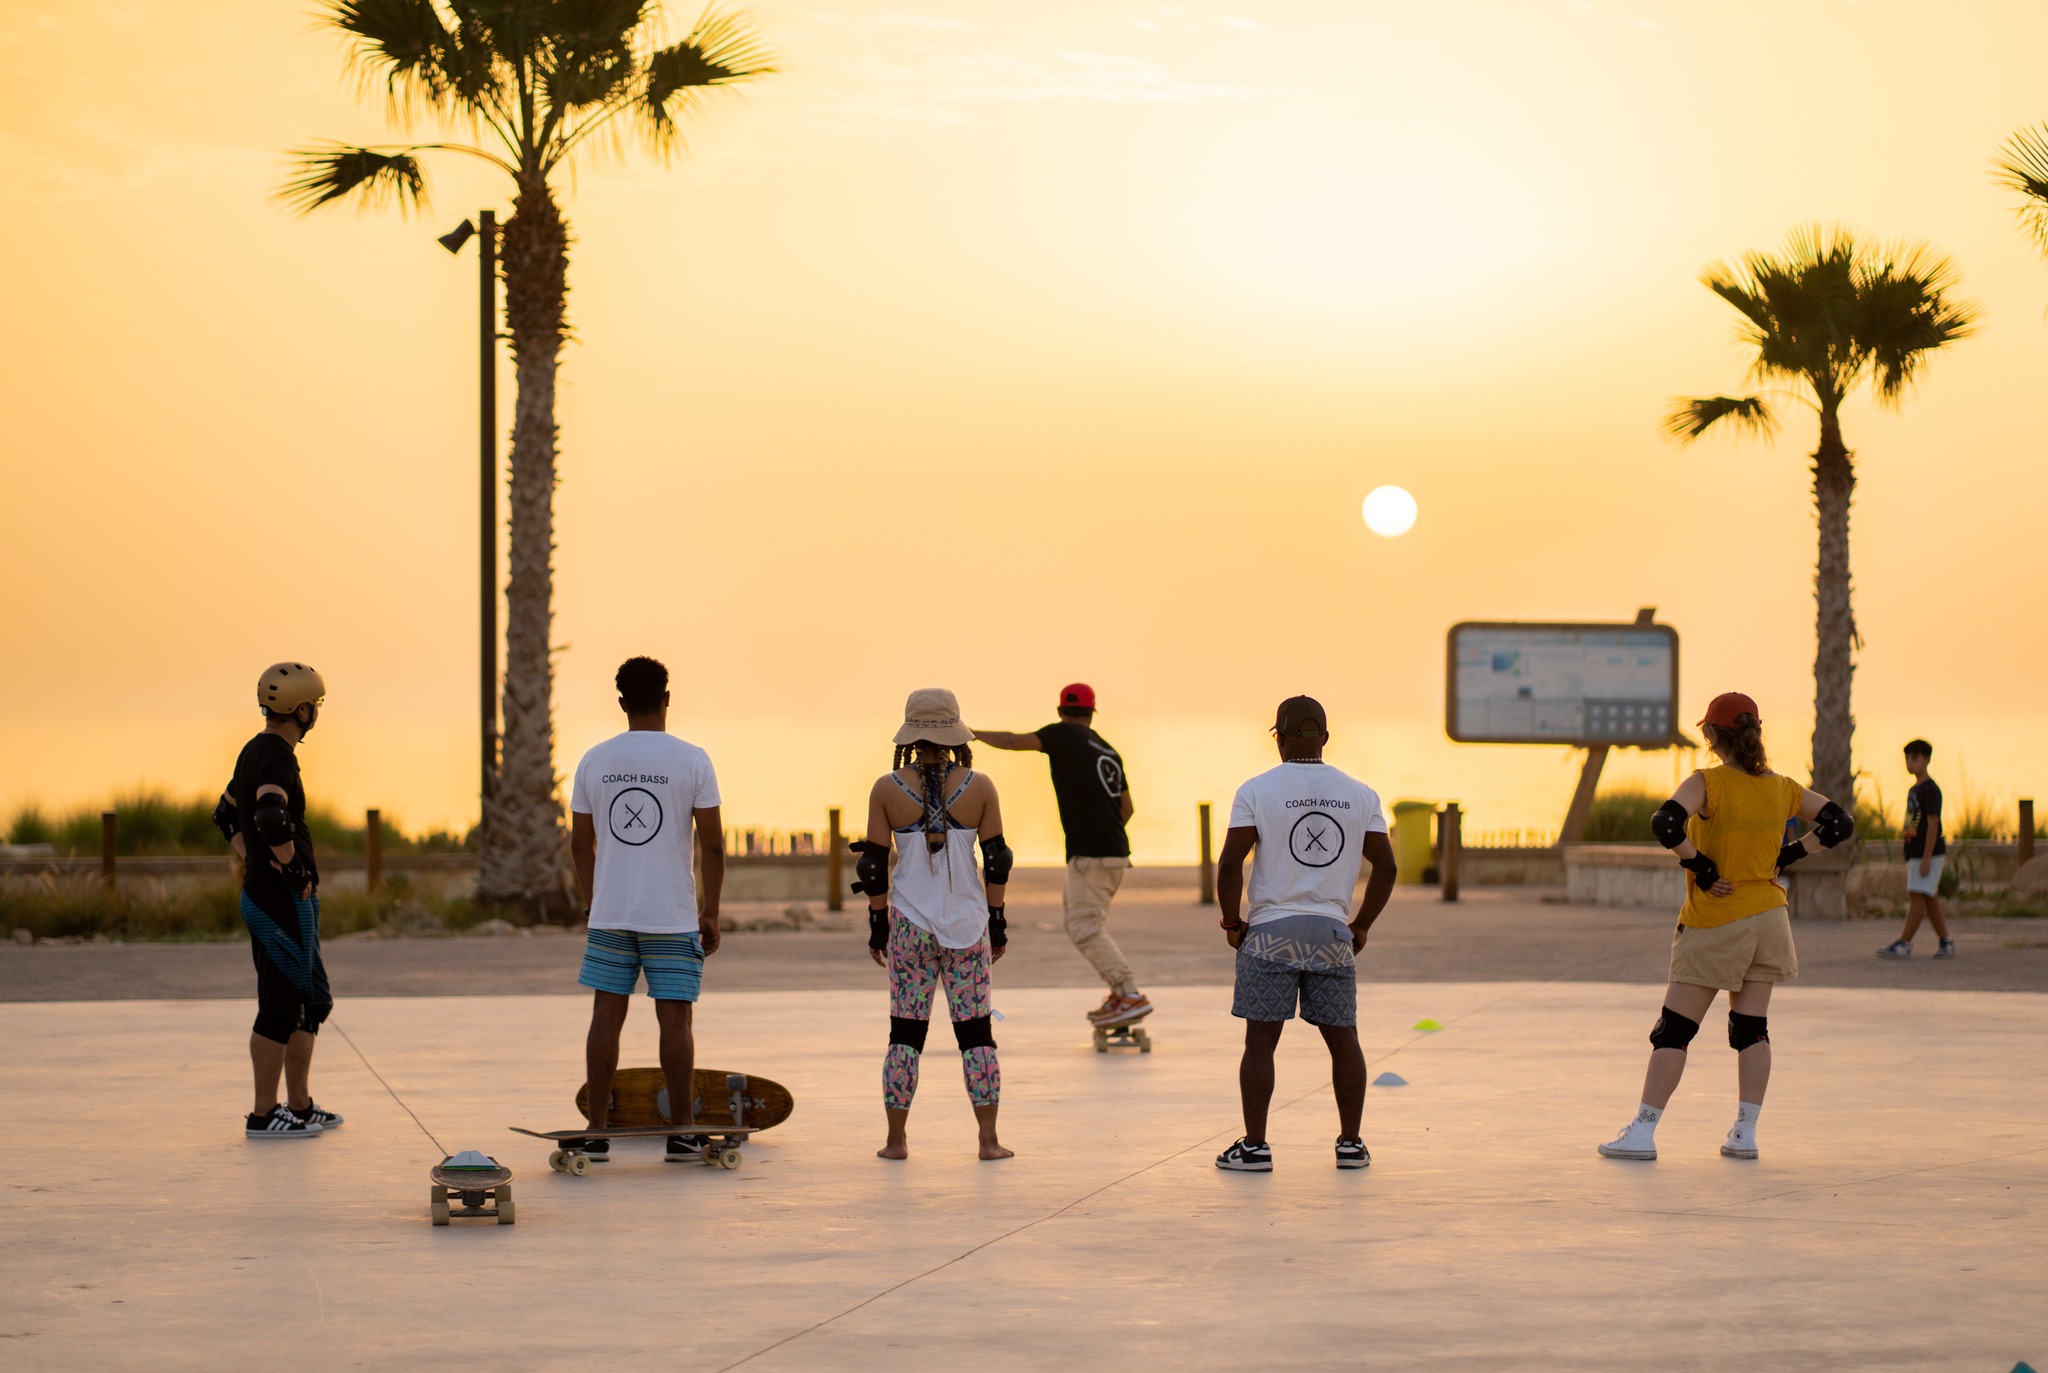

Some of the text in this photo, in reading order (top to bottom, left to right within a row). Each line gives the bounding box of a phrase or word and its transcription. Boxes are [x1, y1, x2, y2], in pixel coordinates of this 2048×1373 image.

[602, 774, 668, 785] COACH BASSI
[954, 788, 962, 797] JUST
[1285, 799, 1350, 809] COACH AYOUB
